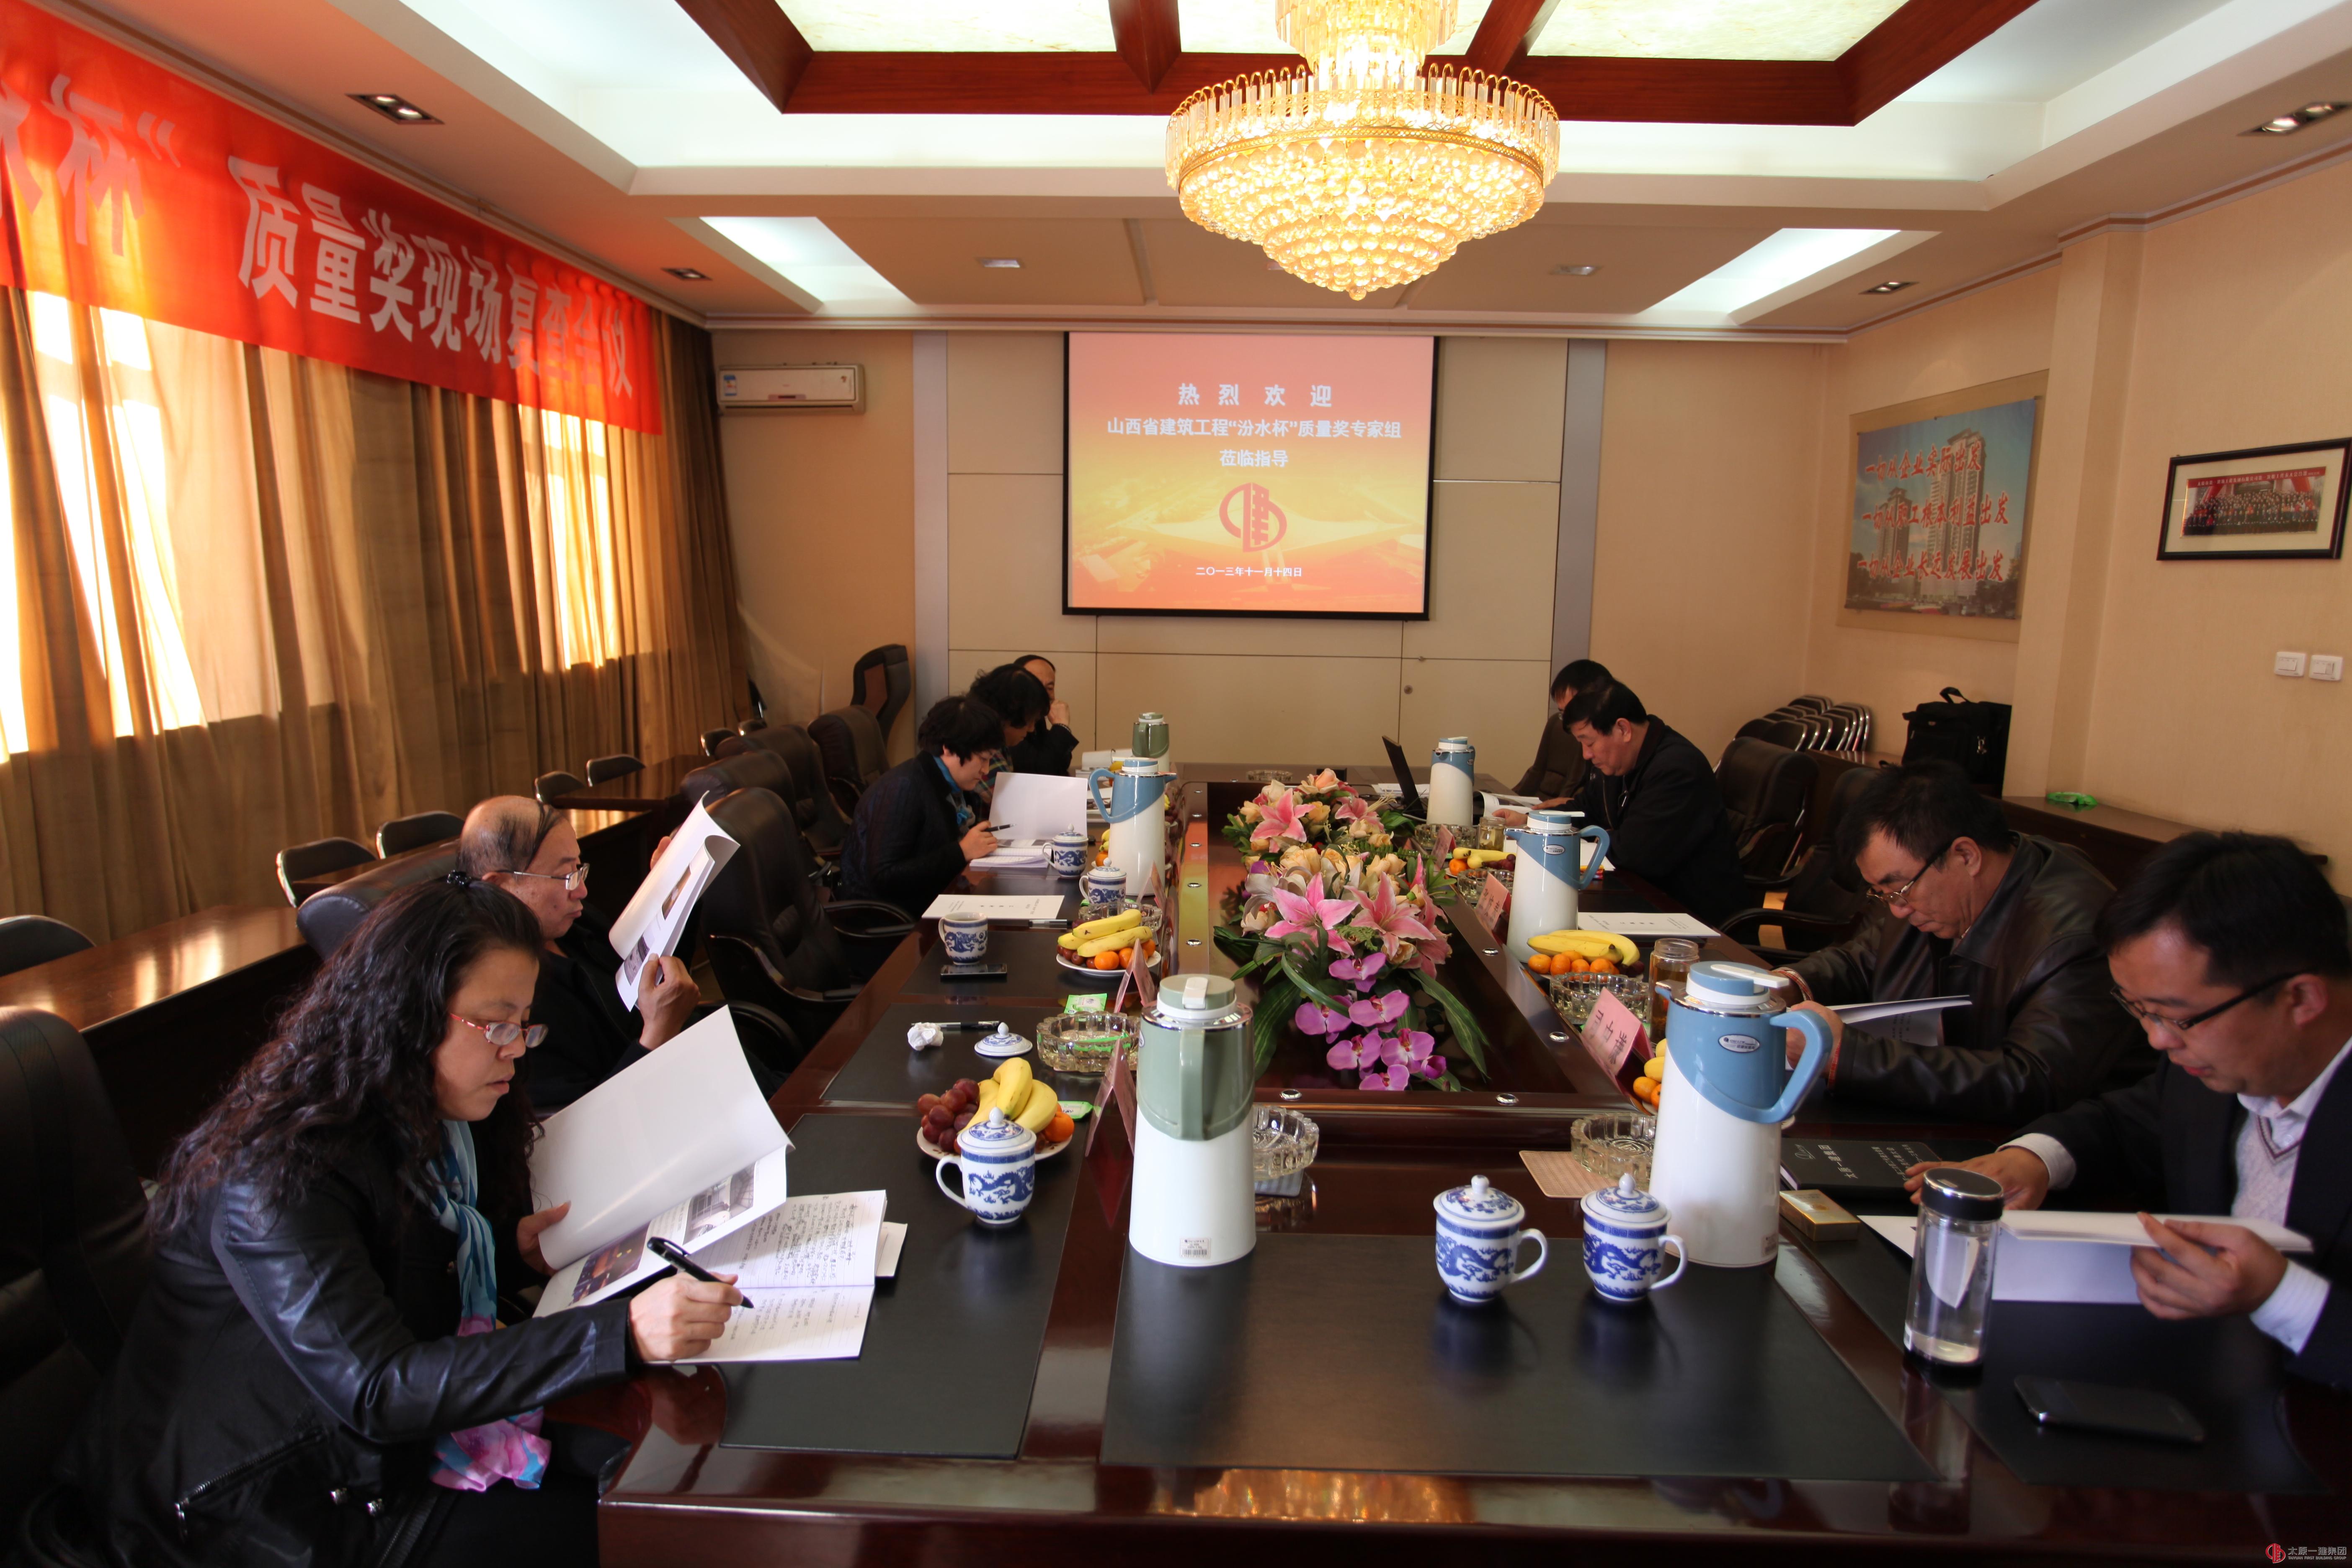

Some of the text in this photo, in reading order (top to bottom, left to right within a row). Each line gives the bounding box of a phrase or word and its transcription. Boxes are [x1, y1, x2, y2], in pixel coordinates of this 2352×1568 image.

[1178, 383, 1332, 407] 热烈欢迎
[1107, 417, 1402, 438] 山西省建筑工程“汾水杯”质量奖专家组
[1219, 449, 1289, 467] 莅临指导
[1865, 440, 1981, 481] 一切从企业实际出发
[1862, 491, 2009, 530] 一切从职工根本利益出发
[1857, 549, 2004, 582] 一切从企业长远发展出发
